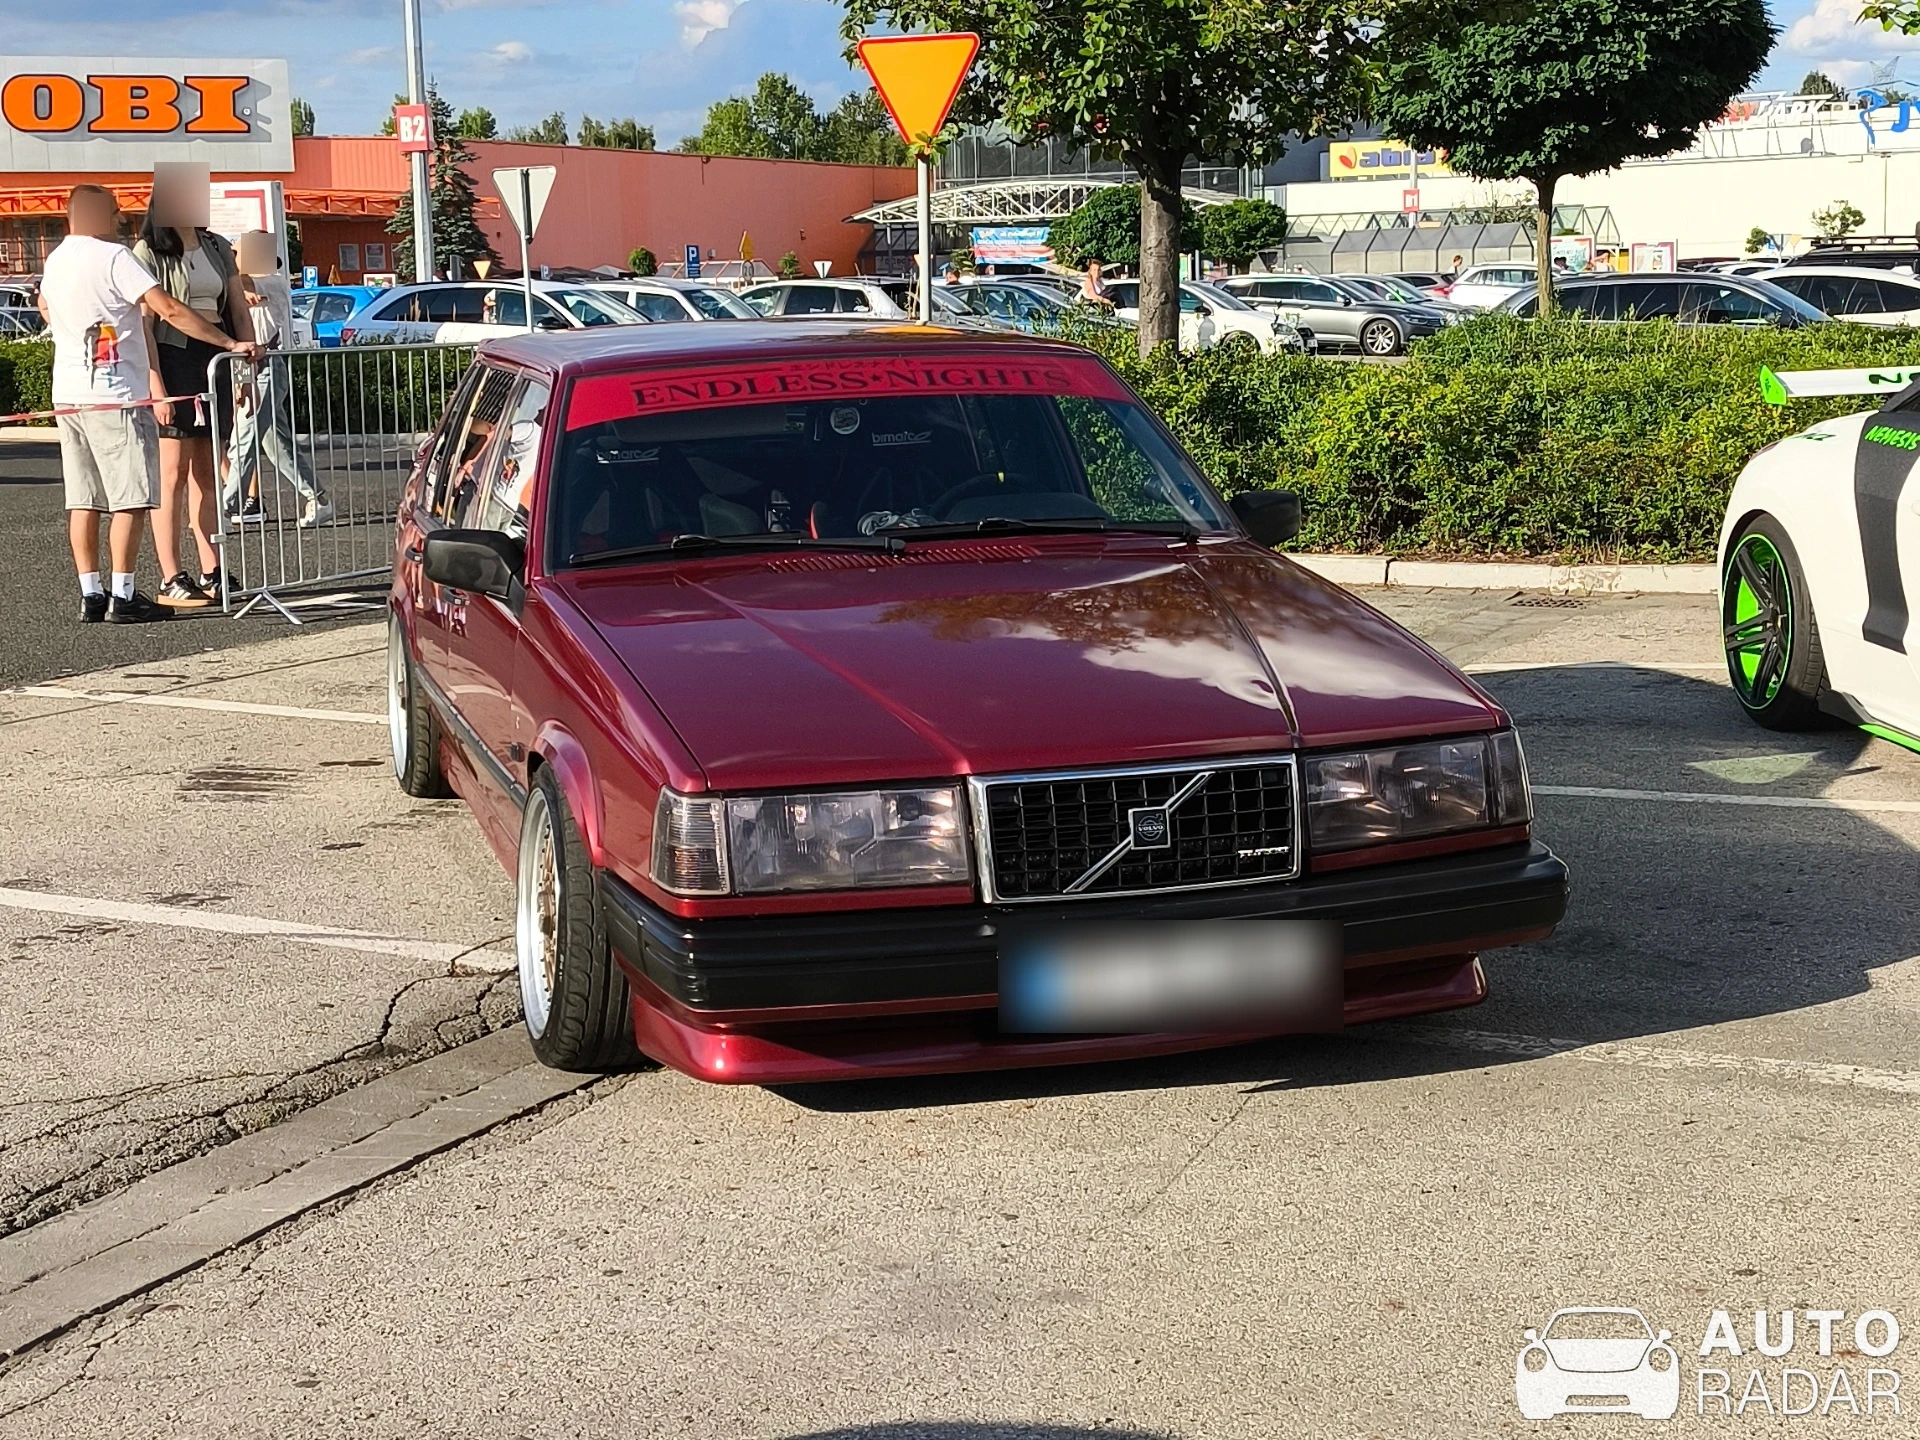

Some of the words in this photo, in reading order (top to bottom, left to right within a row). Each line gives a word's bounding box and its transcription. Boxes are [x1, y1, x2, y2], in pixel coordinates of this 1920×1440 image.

[2, 74, 250, 134] OBI
[399, 114, 426, 142] B2
[632, 370, 868, 406] ENDLESS
[885, 368, 1072, 389] NIGHTS
[1137, 824, 1165, 832] VOLVO
